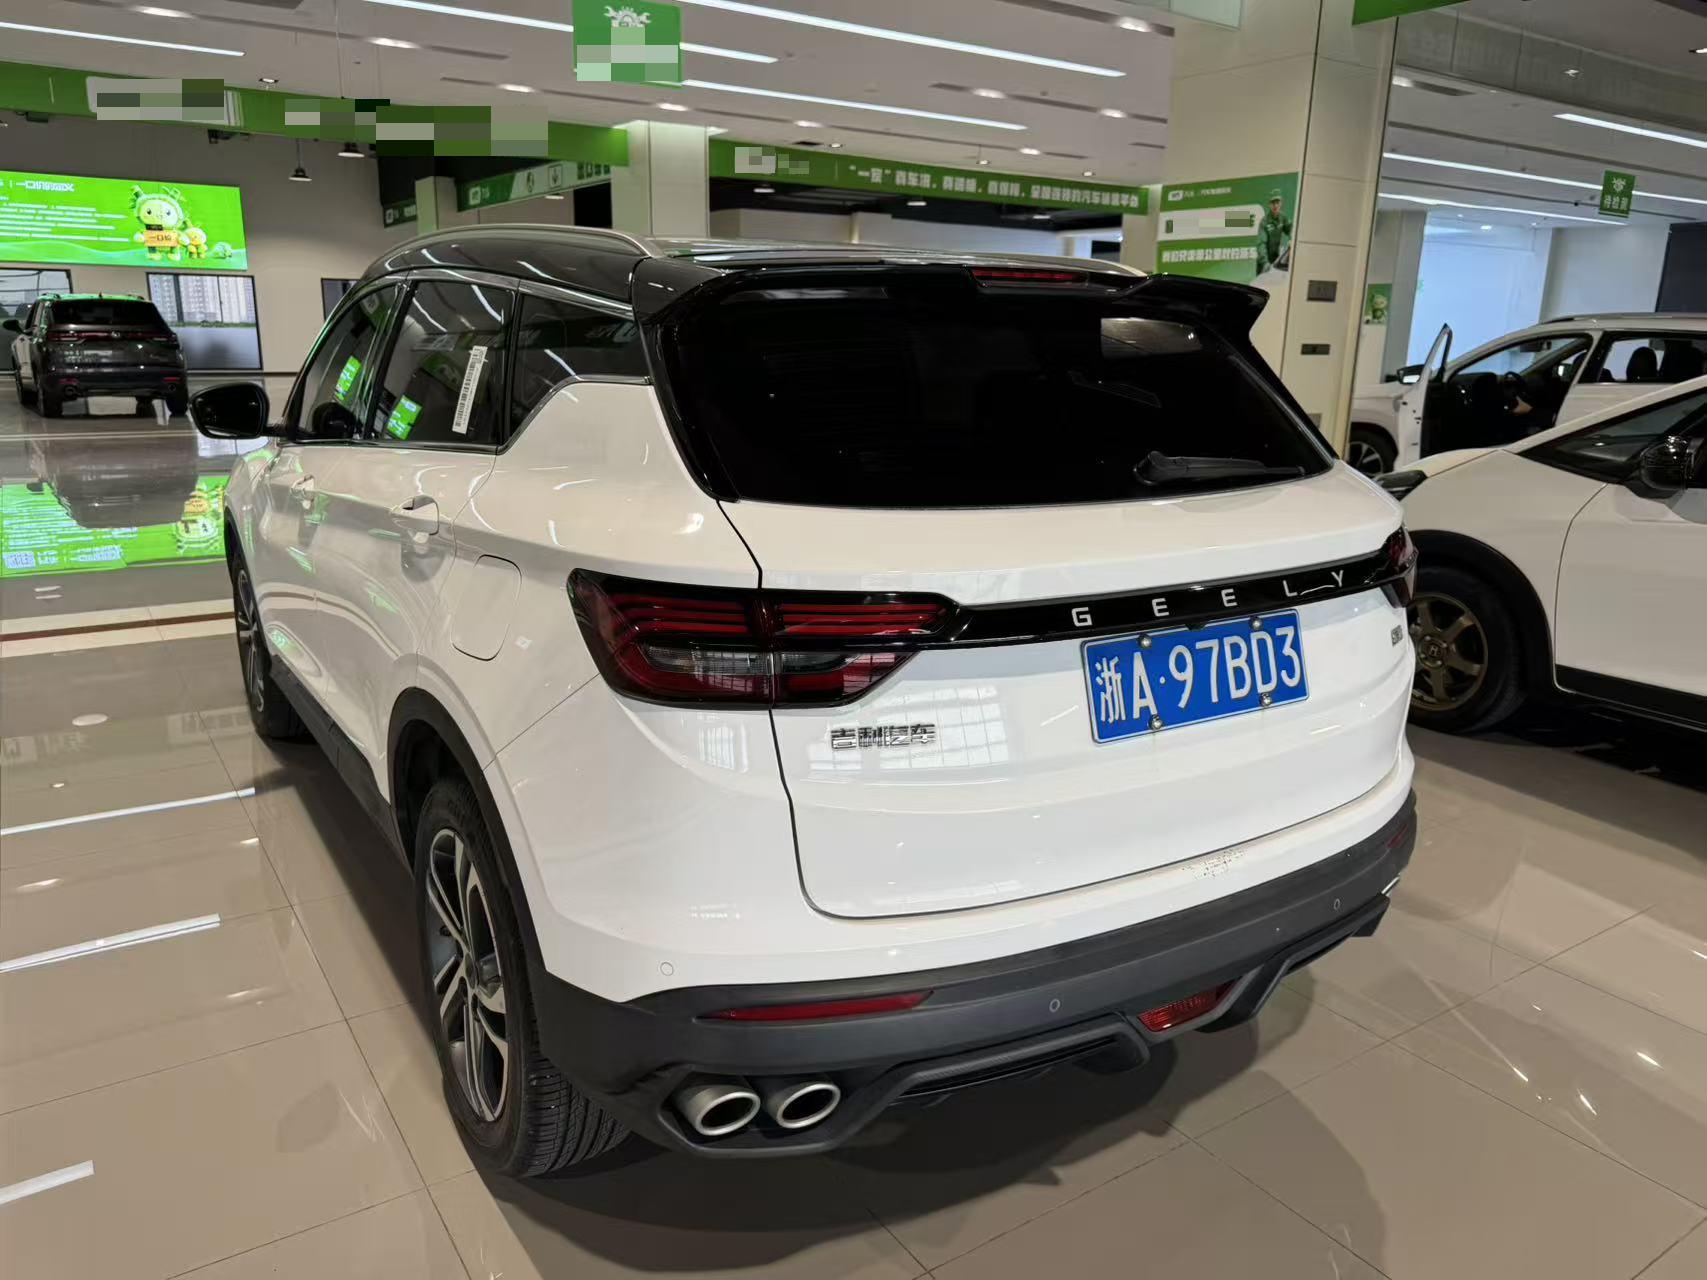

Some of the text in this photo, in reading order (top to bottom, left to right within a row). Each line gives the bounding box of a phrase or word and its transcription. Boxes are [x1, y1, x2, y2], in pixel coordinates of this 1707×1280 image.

[1071, 570, 1345, 627] GEELY
[830, 723, 936, 750] 吉利汽车
